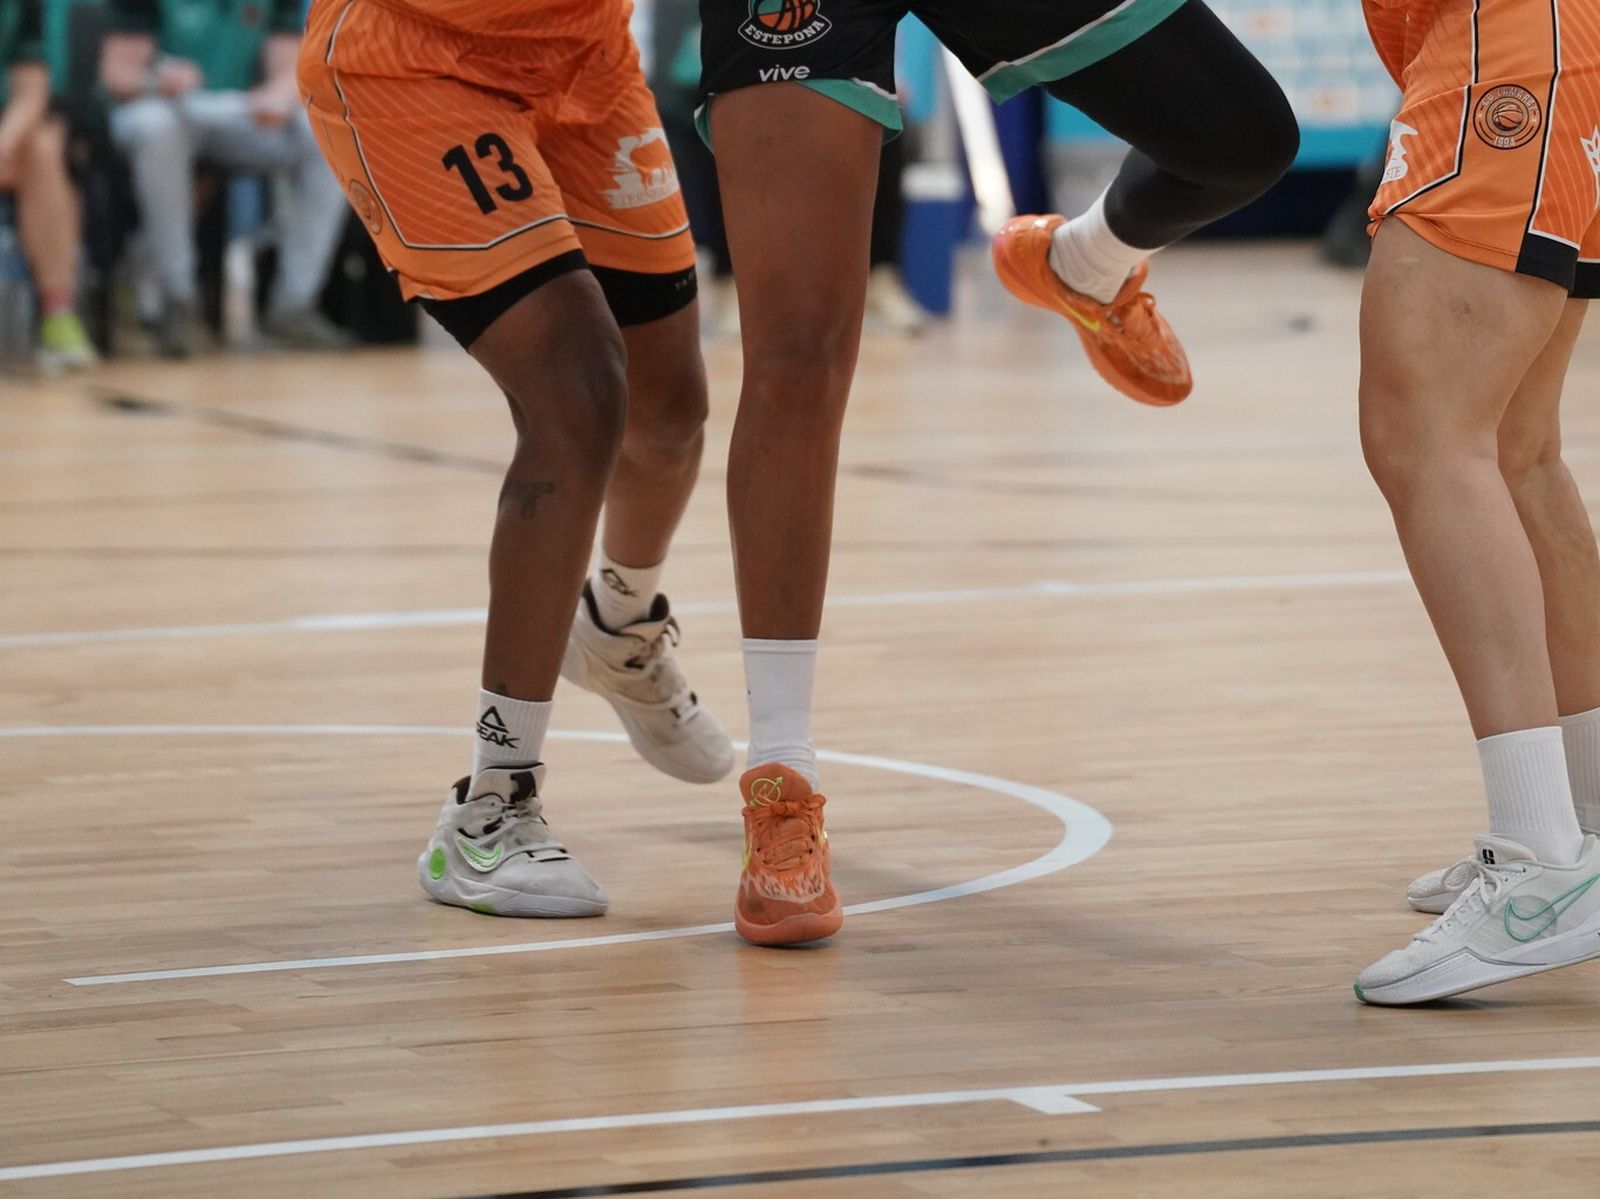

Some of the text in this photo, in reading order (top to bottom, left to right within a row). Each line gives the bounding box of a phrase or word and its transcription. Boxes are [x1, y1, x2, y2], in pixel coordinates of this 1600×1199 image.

[744, 19, 826, 45] ESTEPONA
[758, 64, 811, 82] vive
[441, 132, 534, 215] 13
